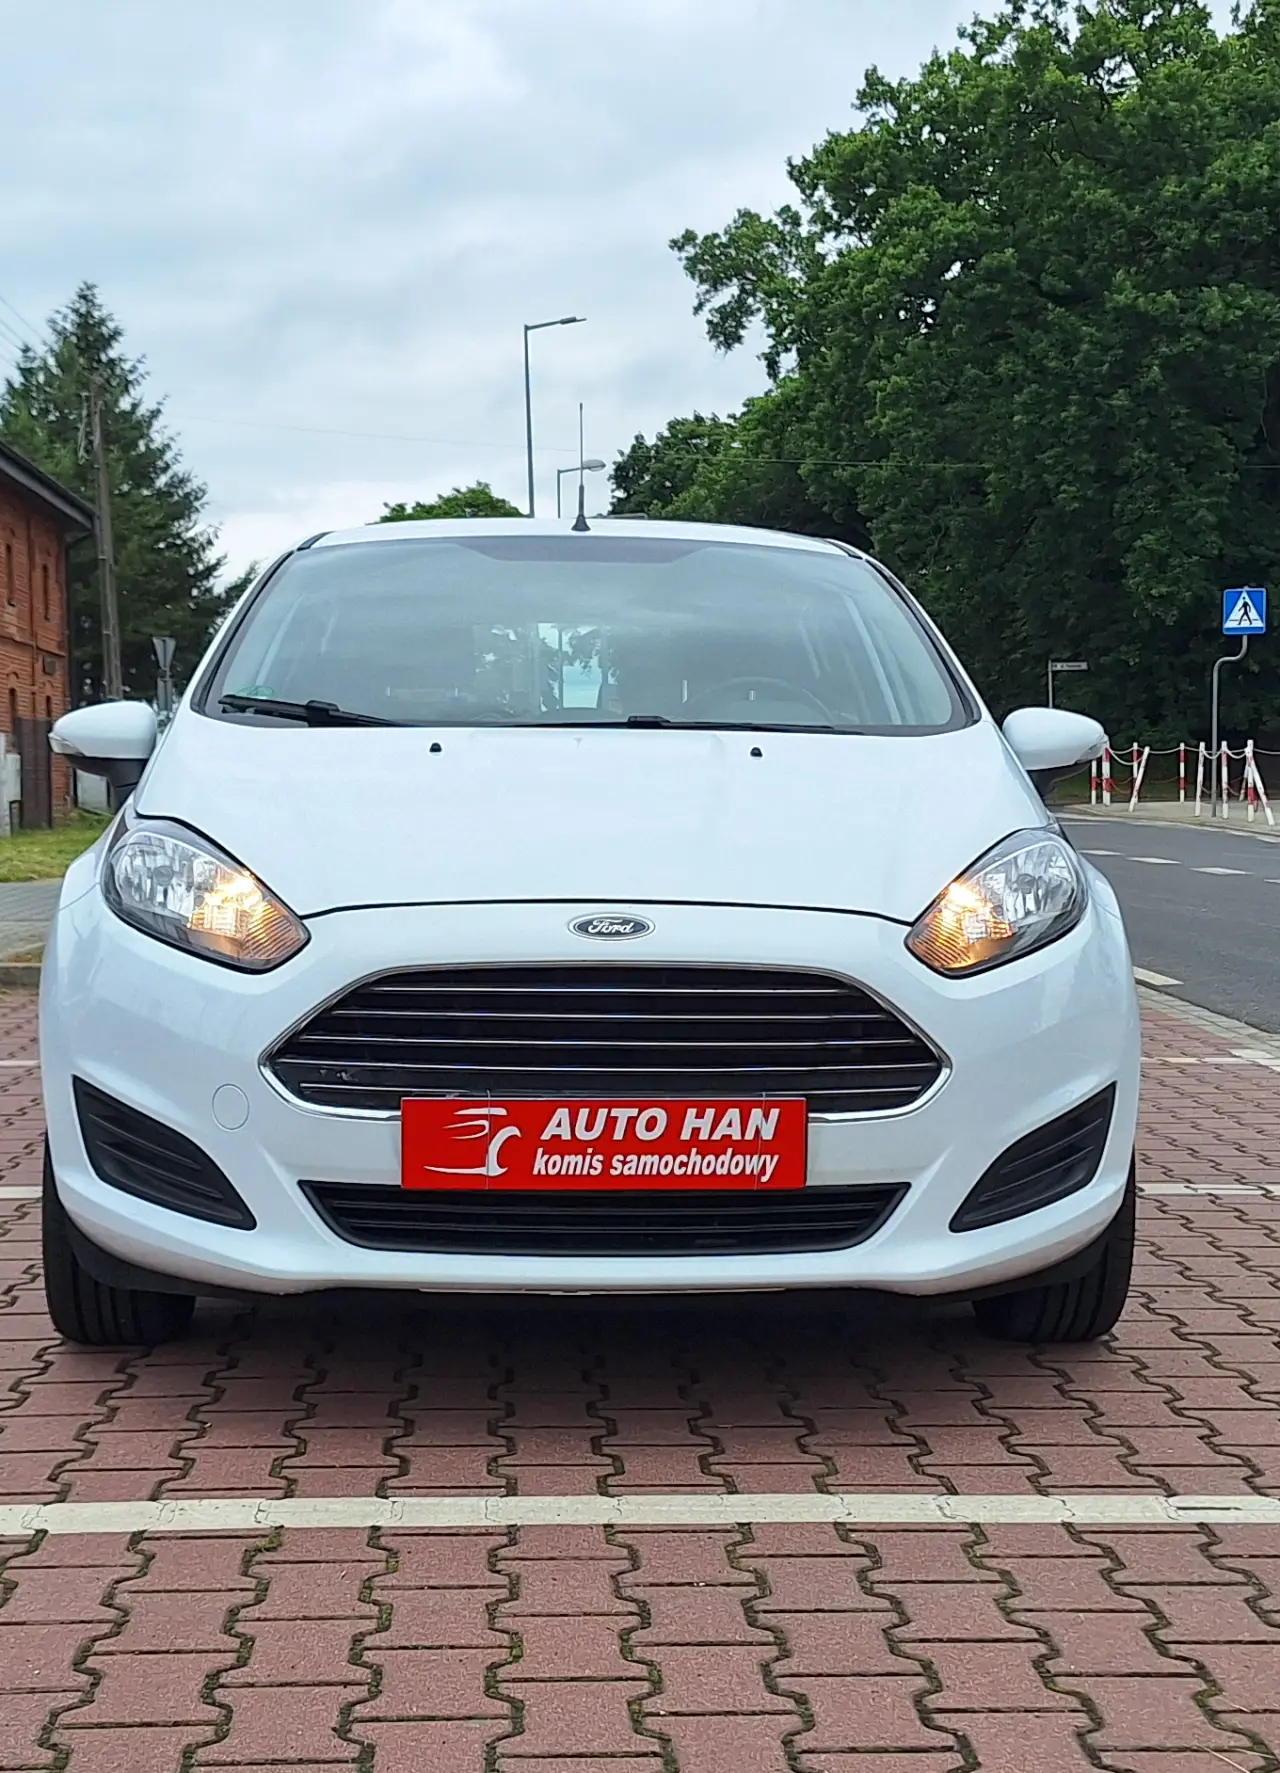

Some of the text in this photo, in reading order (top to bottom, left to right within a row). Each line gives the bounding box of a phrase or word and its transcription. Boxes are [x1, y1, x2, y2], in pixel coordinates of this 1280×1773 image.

[587, 918, 636, 934] Ford
[539, 1107, 781, 1142] AUTO HAN
[532, 1147, 780, 1184] komis samochodowy
